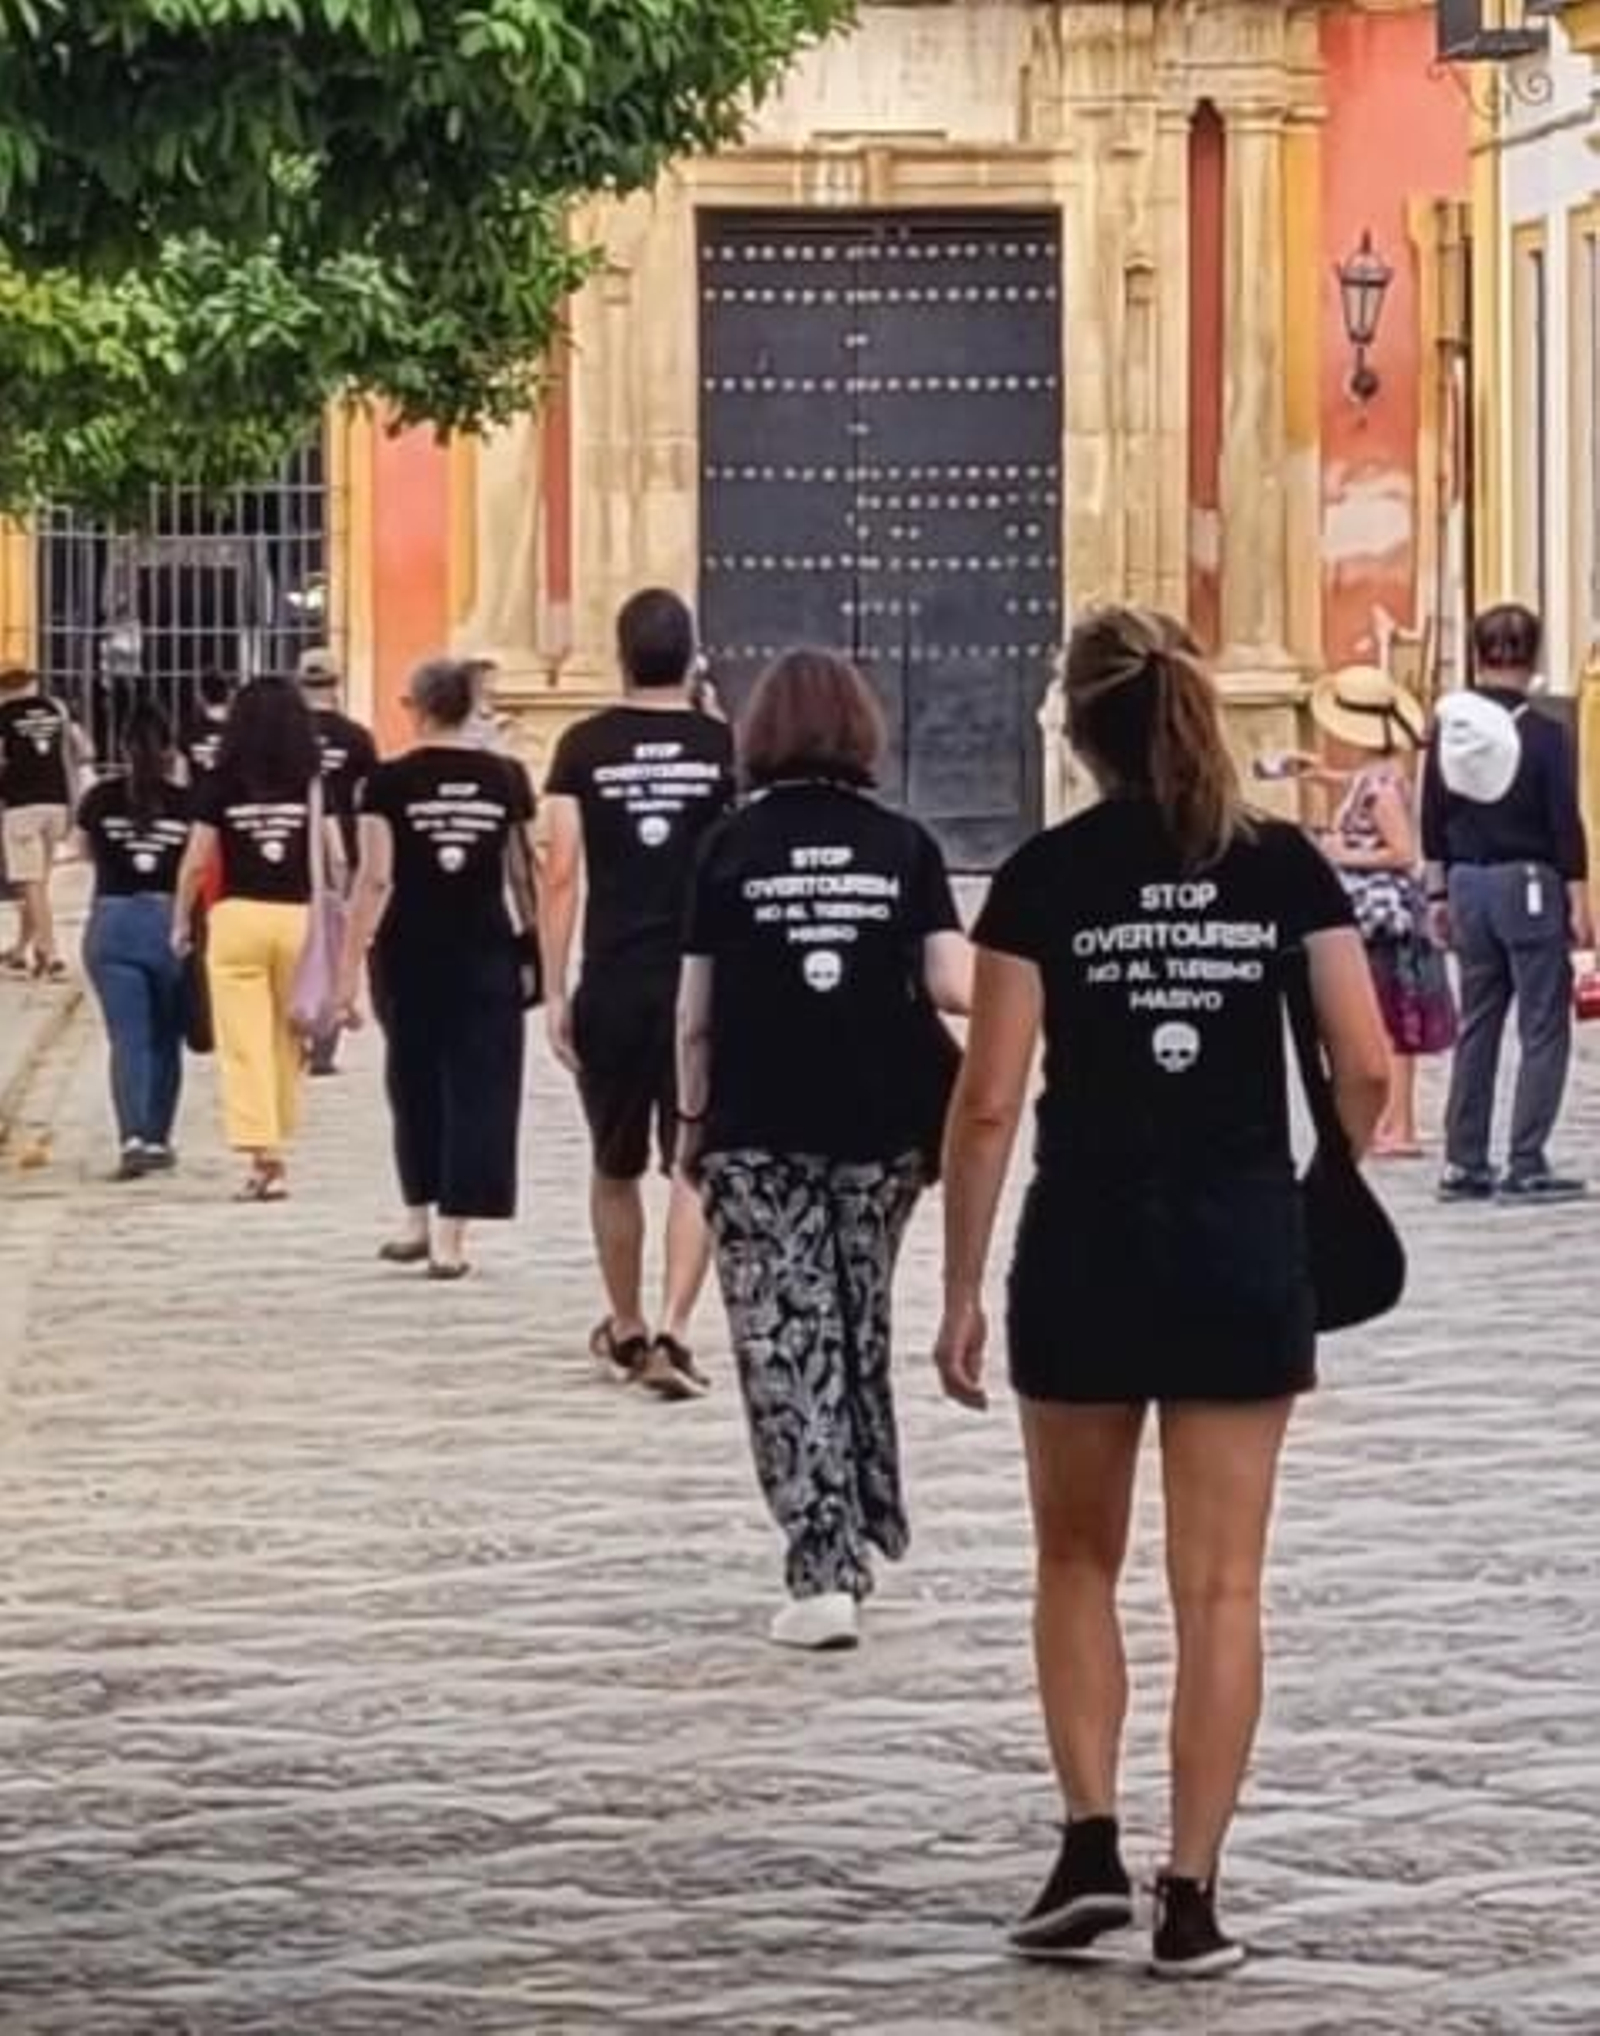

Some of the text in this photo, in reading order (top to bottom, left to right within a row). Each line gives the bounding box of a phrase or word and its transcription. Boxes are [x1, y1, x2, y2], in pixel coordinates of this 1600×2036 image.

[790, 847, 853, 868] STOP
[1140, 881, 1218, 910] STOP
[1073, 921, 1277, 955] OVERTOURISM
[1088, 959, 1263, 981] NO AL TURISMO
[1129, 989, 1223, 1010] MASIVO
